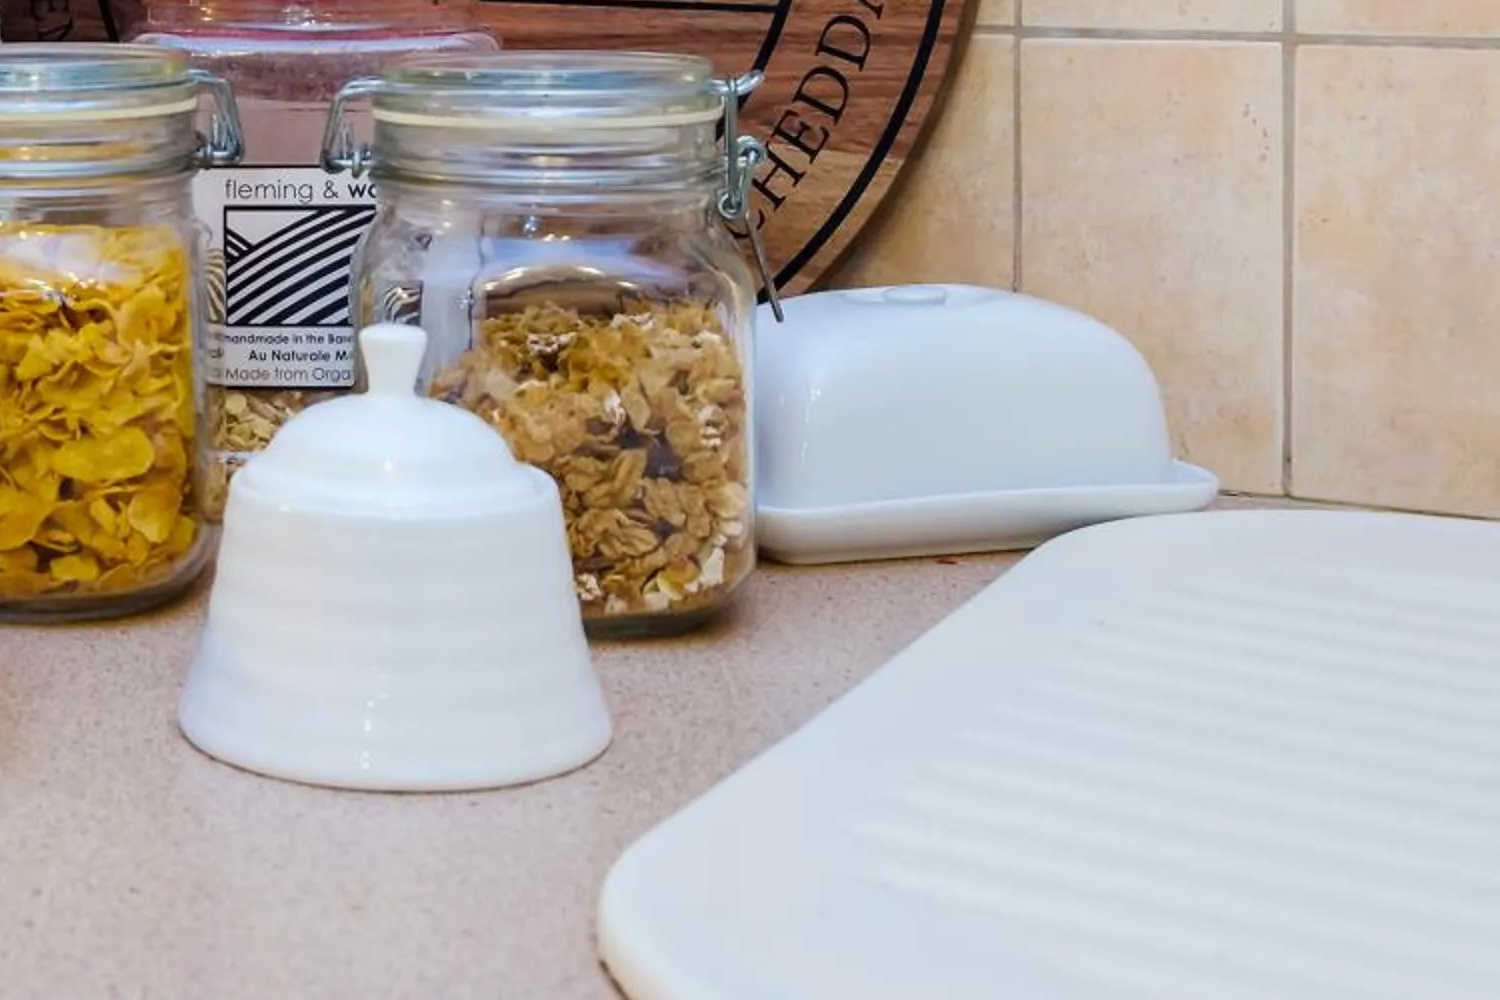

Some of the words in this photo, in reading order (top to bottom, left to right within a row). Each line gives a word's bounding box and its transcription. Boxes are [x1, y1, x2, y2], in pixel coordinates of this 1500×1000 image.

[225, 179, 314, 204] fleming
[322, 180, 340, 199] &
[293, 332, 304, 345] in
[306, 332, 325, 345] the
[247, 350, 267, 362] Au
[271, 349, 331, 362] Naturale
[334, 350, 349, 362] M
[225, 367, 270, 380] Made
[275, 367, 308, 380] from
